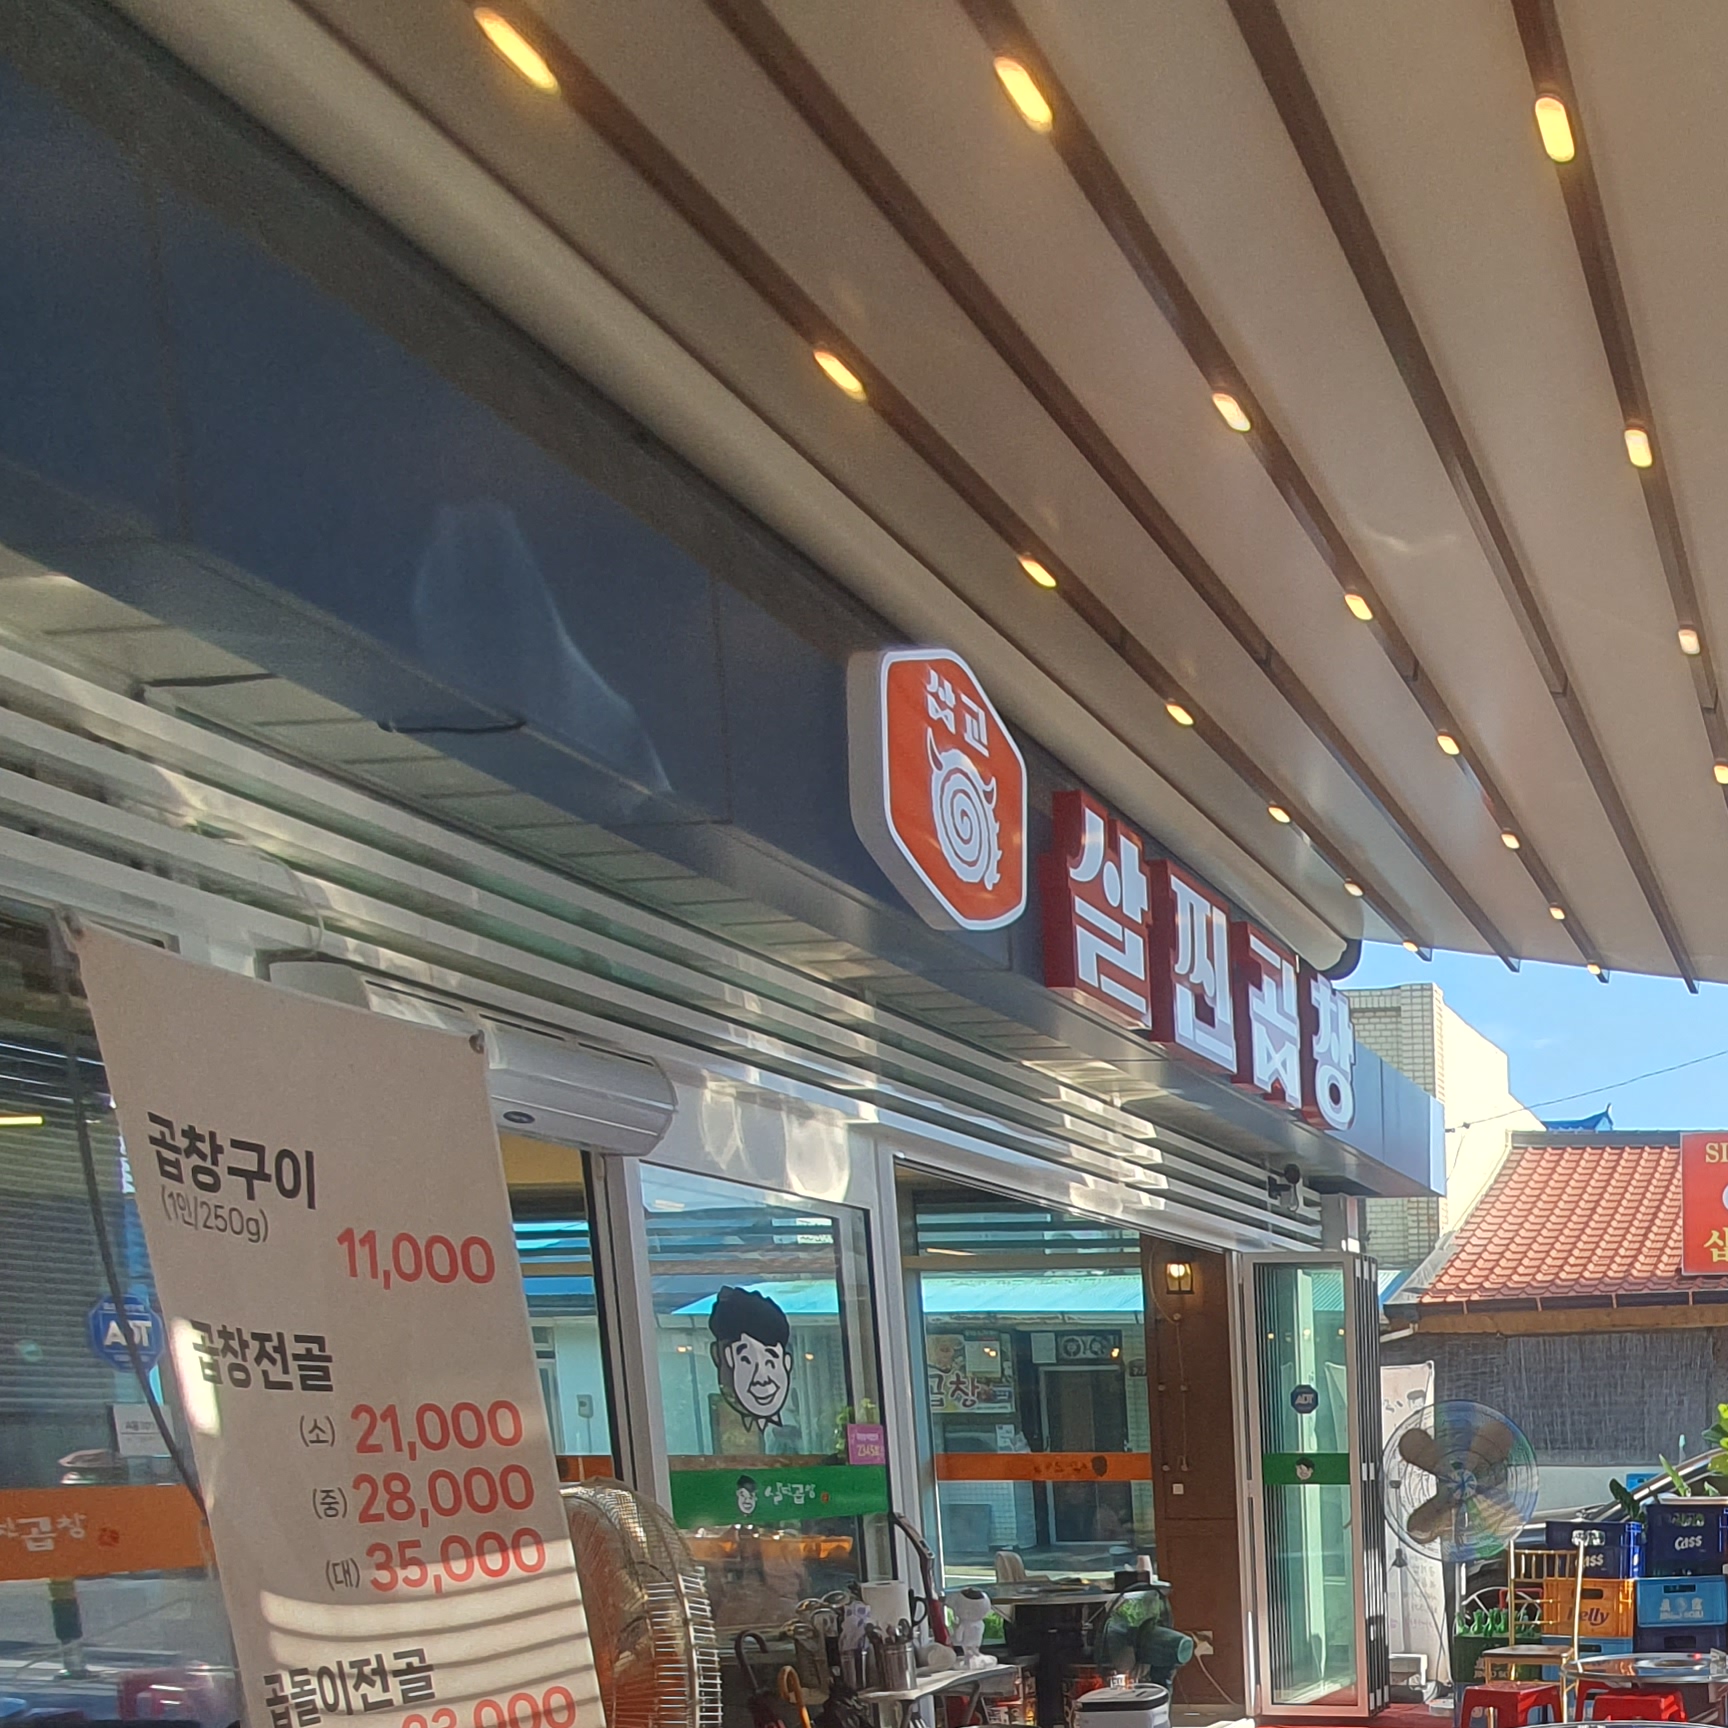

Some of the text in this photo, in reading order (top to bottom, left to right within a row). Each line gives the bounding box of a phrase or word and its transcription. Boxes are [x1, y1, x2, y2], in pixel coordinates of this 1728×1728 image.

[1068, 806, 1355, 1131] 살찐곱창
[147, 1112, 316, 1210] 곱창구이
[161, 1188, 269, 1244] (1인/250g)
[336, 1227, 496, 1290] 11,000
[191, 1321, 333, 1392] 곱창전골
[301, 1399, 523, 1461] (소) 21,000
[312, 1464, 535, 1527] (중) 28,000
[325, 1527, 546, 1594] (대) 35,000
[1674, 1535, 1702, 1551] Cass
